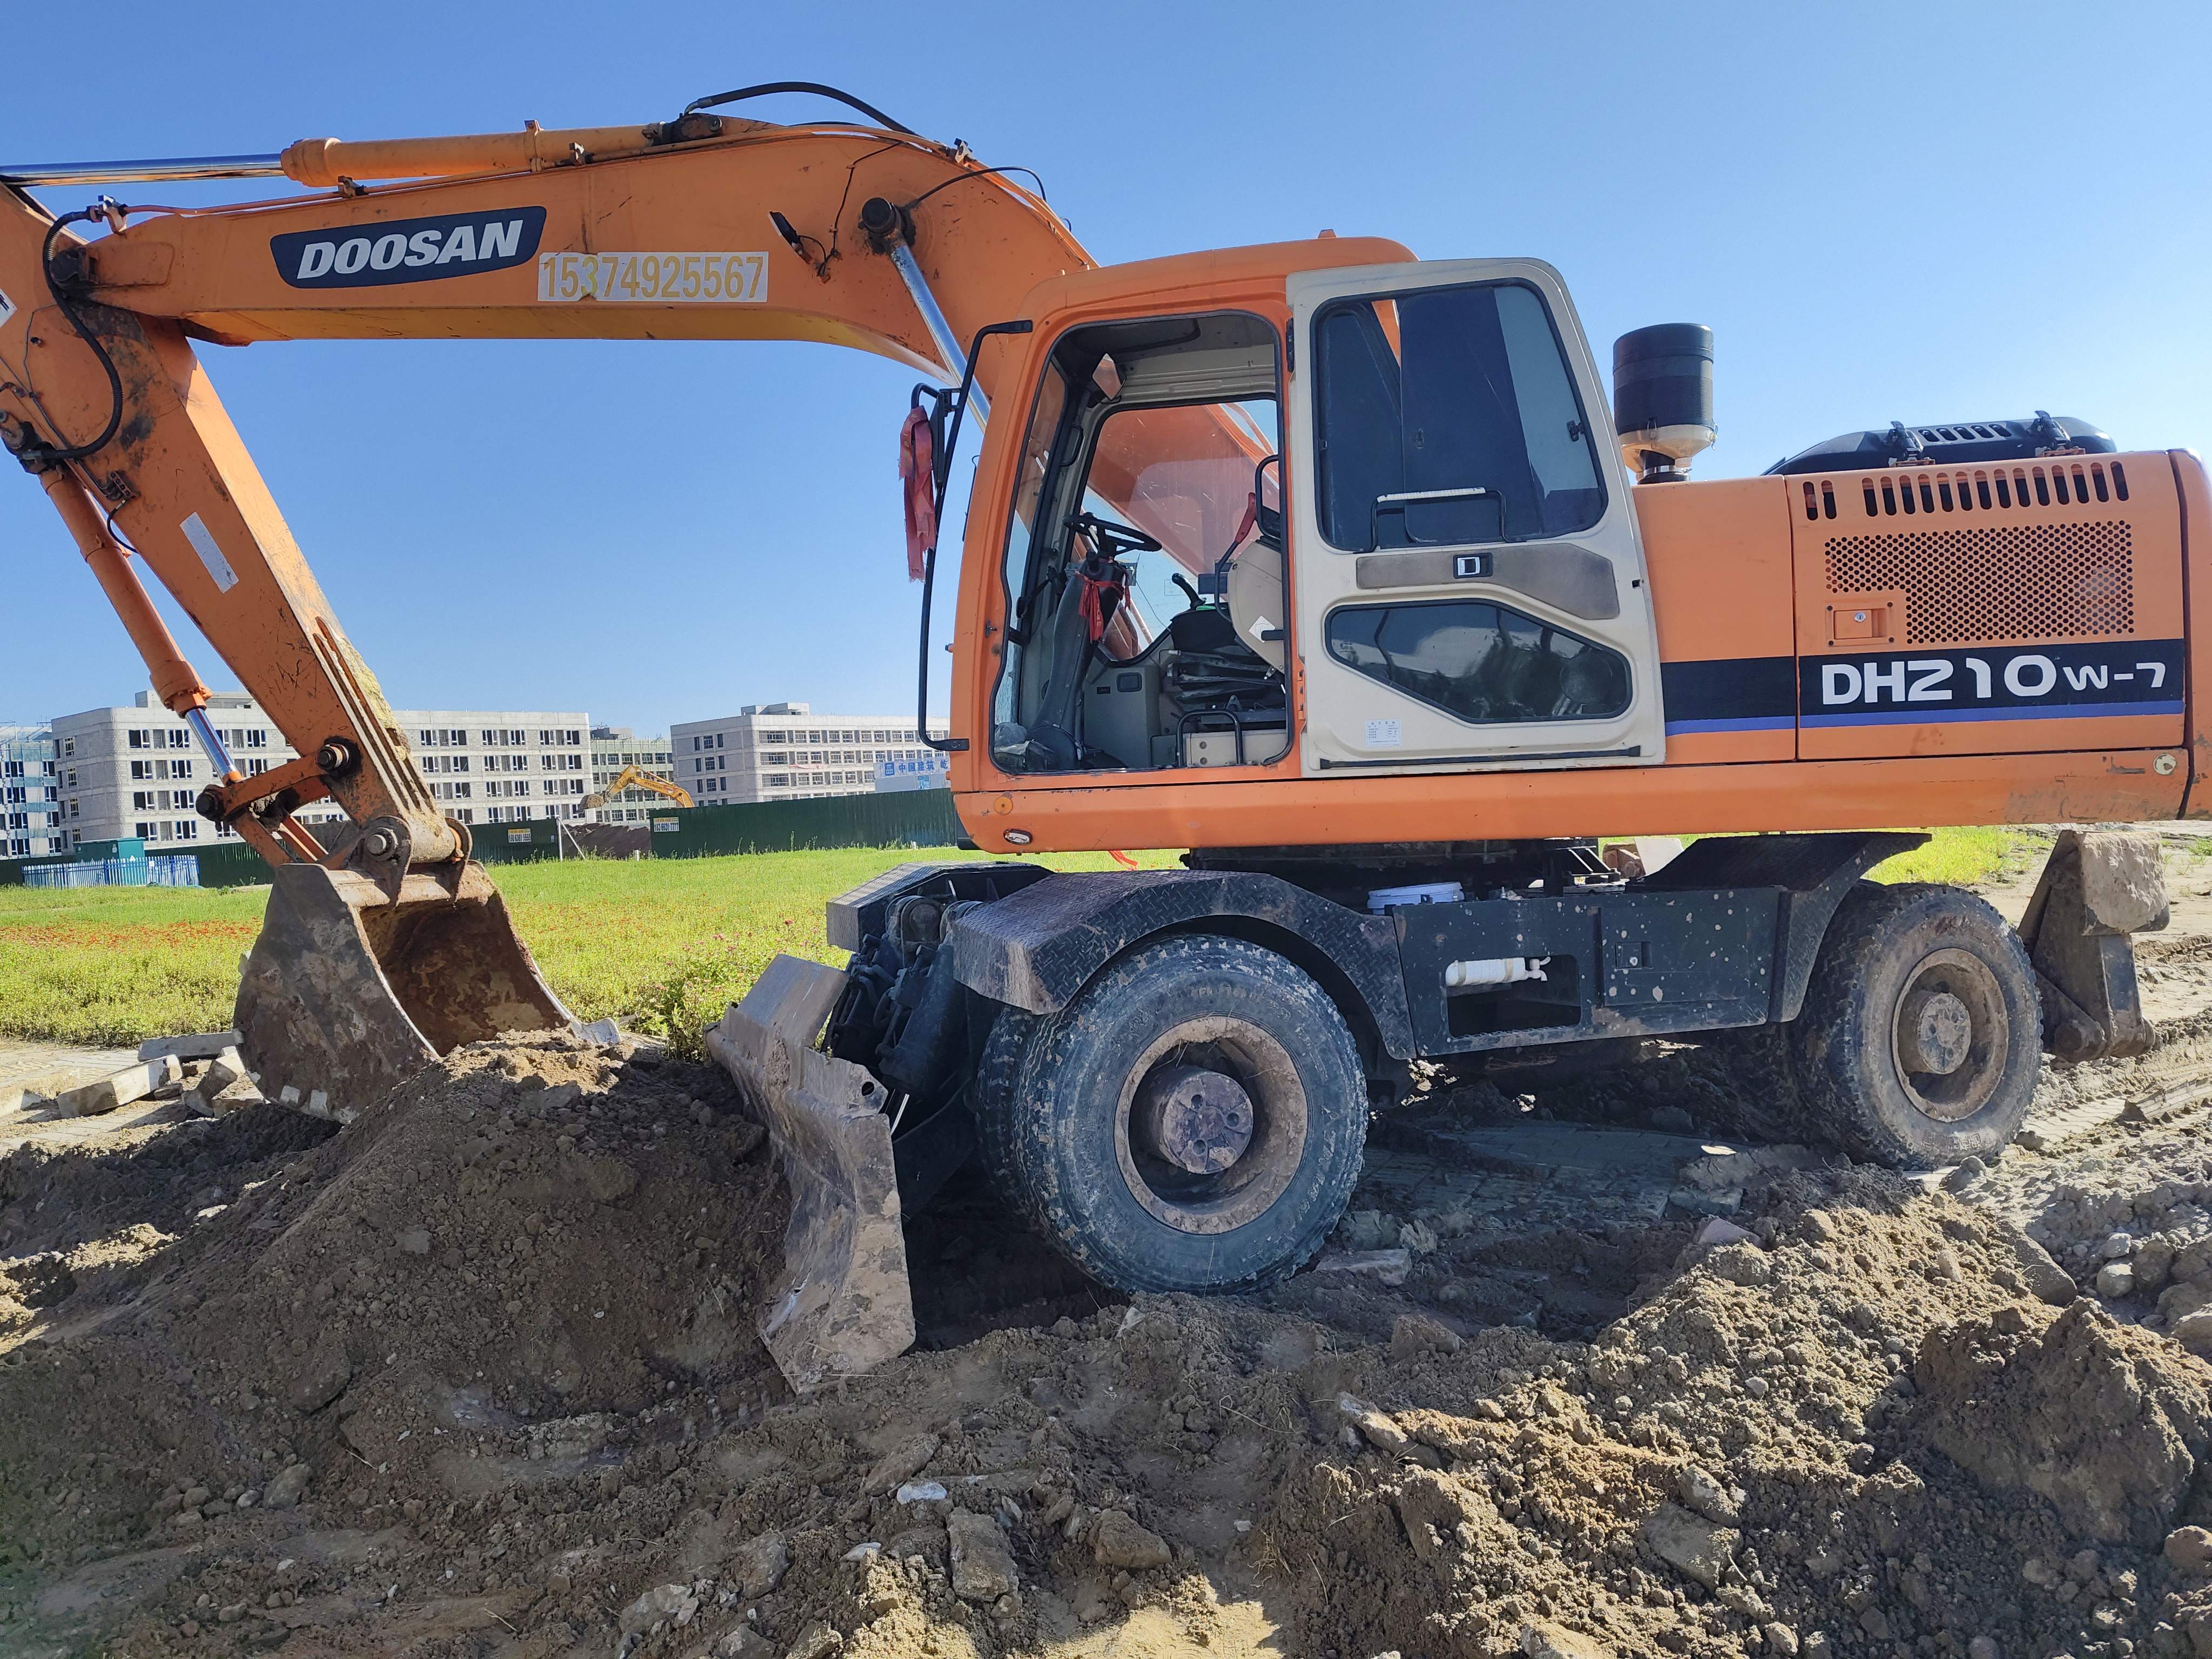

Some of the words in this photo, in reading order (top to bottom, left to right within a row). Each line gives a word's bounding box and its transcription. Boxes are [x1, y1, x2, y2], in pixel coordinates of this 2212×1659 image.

[297, 220, 523, 279] DOOSAN
[543, 255, 764, 298] 15374925567
[644, 781, 663, 790] HYUNDAI
